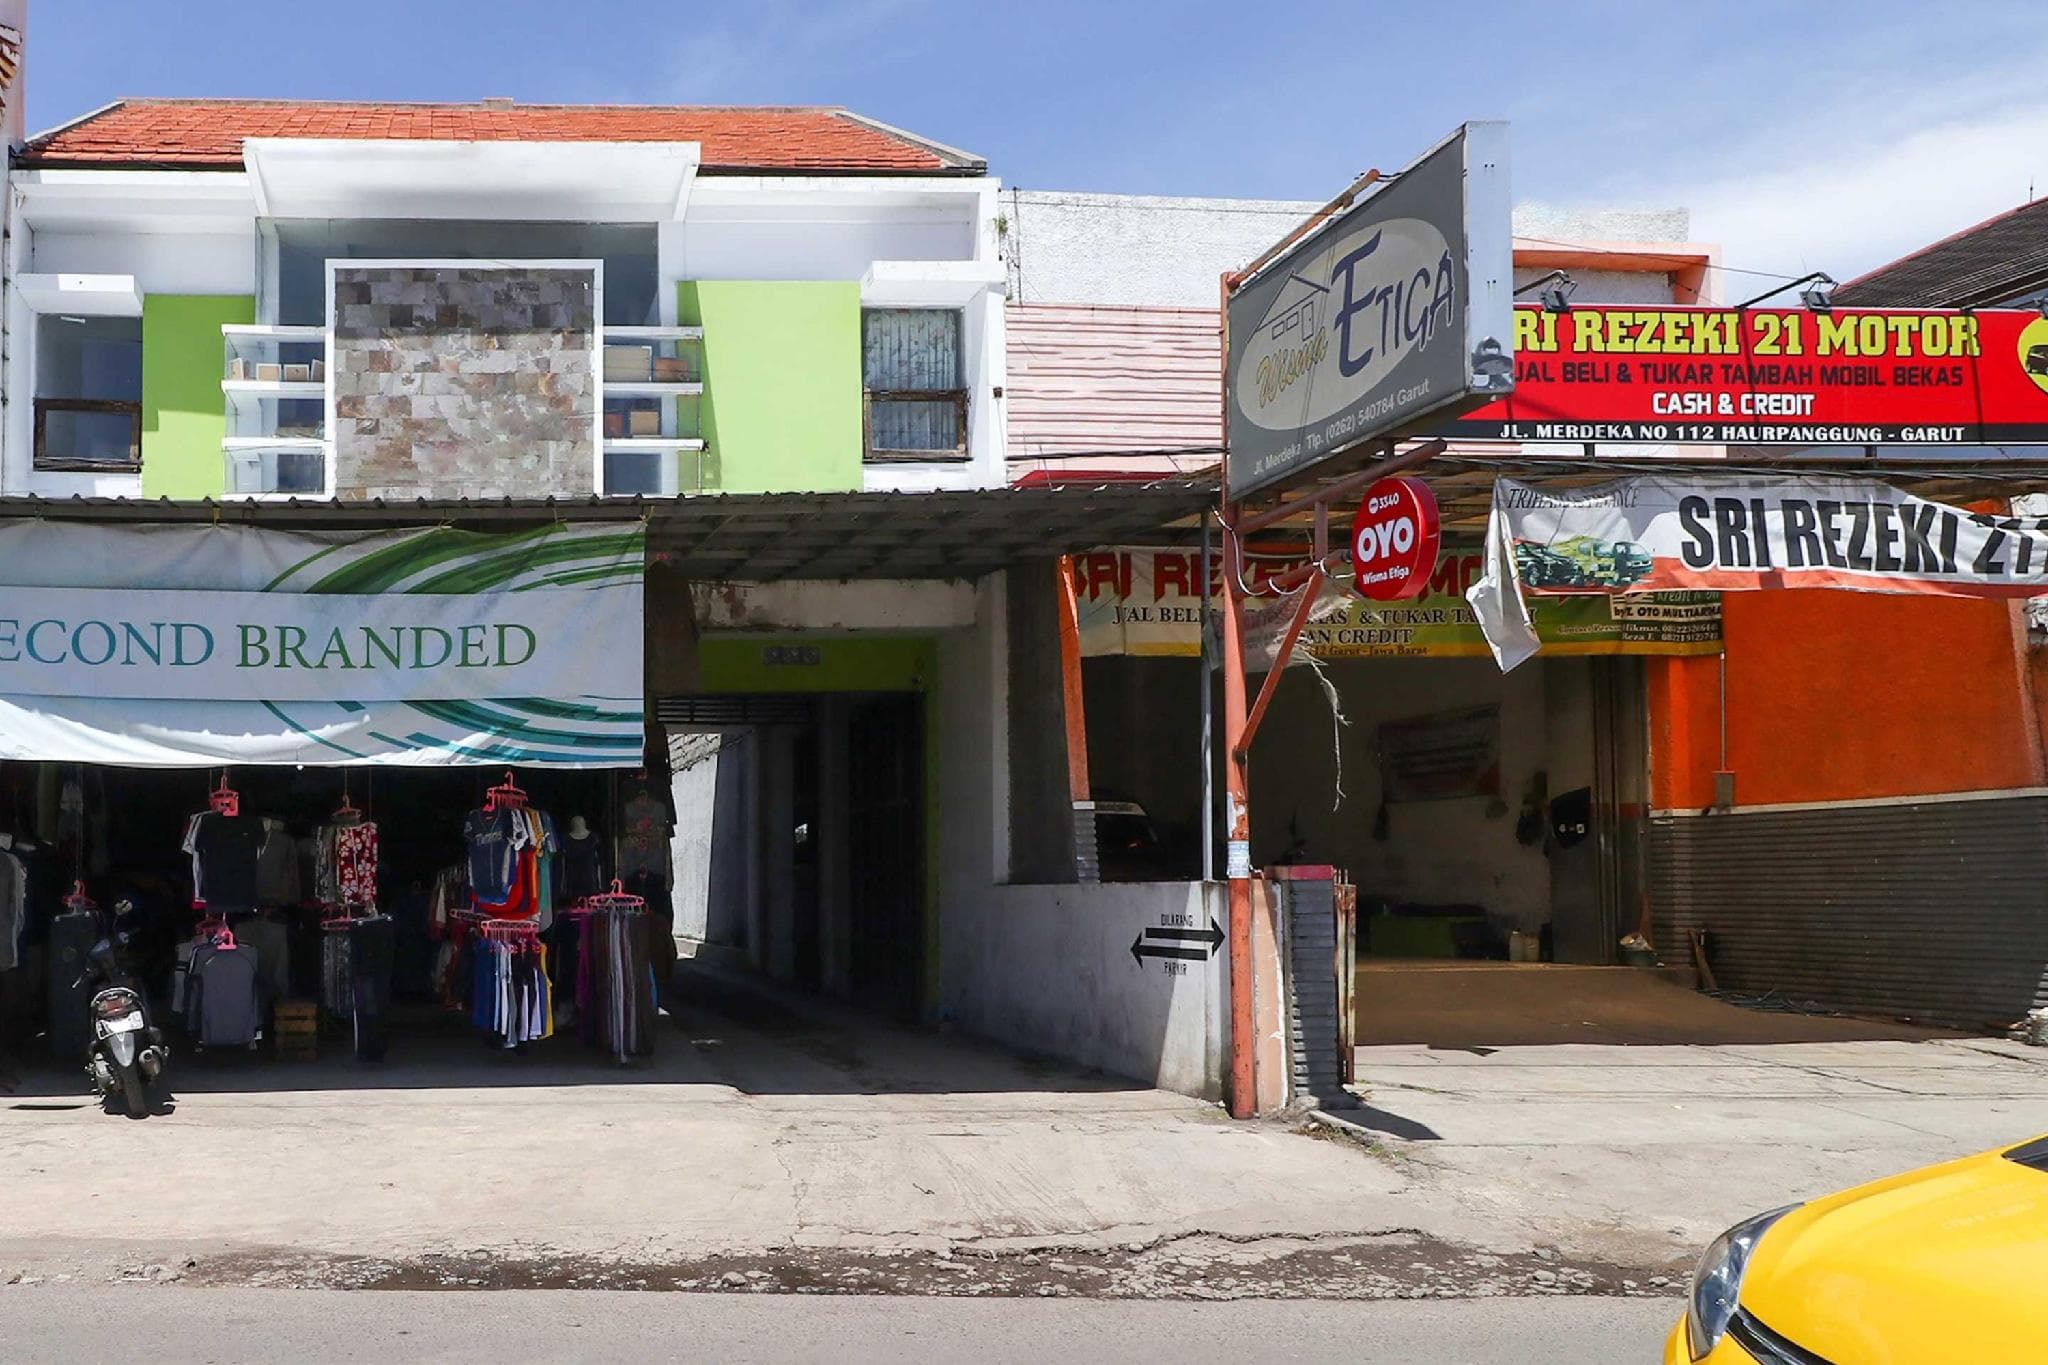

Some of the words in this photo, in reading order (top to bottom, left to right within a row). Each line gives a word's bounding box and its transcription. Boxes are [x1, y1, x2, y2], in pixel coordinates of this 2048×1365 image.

[1572, 310, 1742, 356] REZEKI
[1752, 313, 1805, 356] 21
[1815, 314, 1982, 358] MOTOR
[1562, 363, 1611, 383] BELI
[1616, 365, 1632, 384] &
[1641, 363, 1714, 385] TUKAR
[1721, 364, 1813, 386] TAMBAH
[1820, 366, 1887, 387] MOBIL
[1893, 366, 1964, 387] BEKAS
[1325, 414, 1356, 444] (0262)
[1358, 395, 1395, 427] 540784
[1397, 378, 1431, 407] Garut
[1652, 391, 1713, 415] CASH
[1717, 393, 1735, 415] &
[1740, 393, 1816, 416] CREDIT
[1500, 424, 1529, 440] JL.
[1536, 424, 1635, 440] MERDEKA
[1640, 425, 1668, 440] NO
[1676, 425, 1715, 441] 112
[1721, 426, 1883, 442] HAURPANGGUNG
[1901, 427, 1966, 442] GARUT
[1357, 516, 1414, 562] OYO
[1678, 495, 1771, 568] SRI
[1780, 497, 1958, 573] REZEKI
[1362, 572, 1388, 585] Wisma
[1359, 609, 1373, 625] &
[1379, 609, 1445, 625] TUKAR
[235, 623, 538, 671] BRANDED
[1338, 629, 1413, 645] CREDIT
